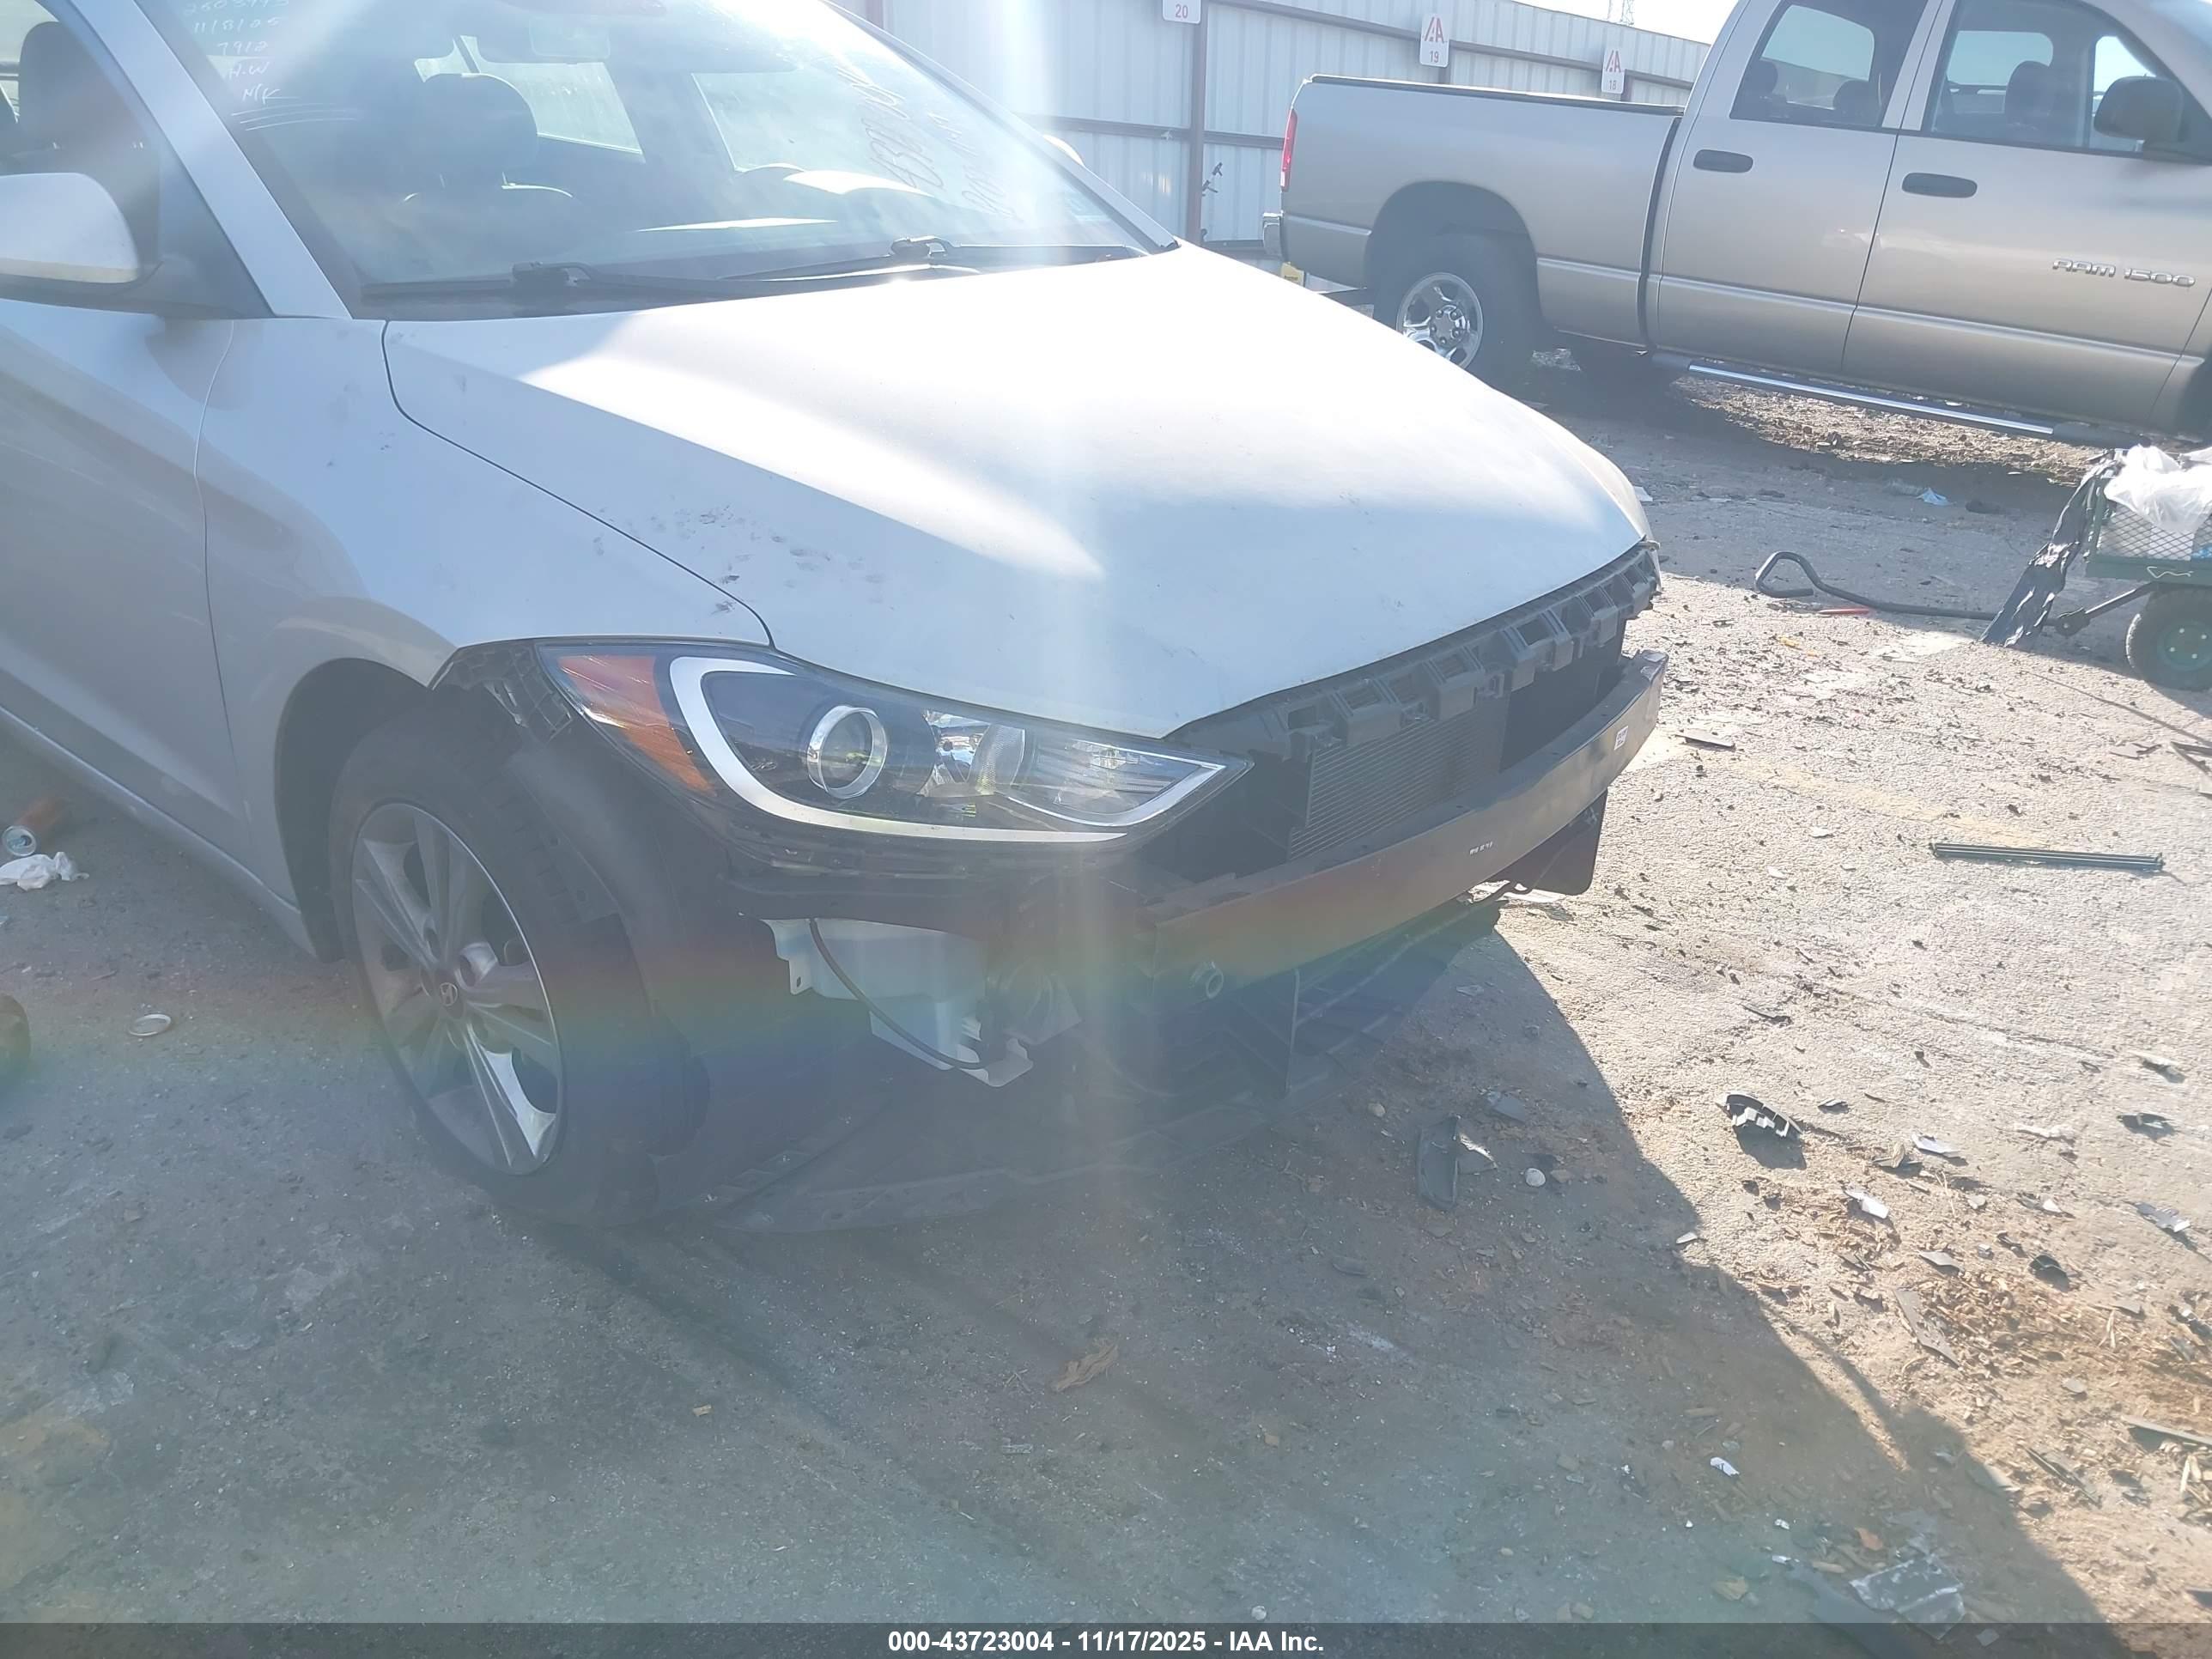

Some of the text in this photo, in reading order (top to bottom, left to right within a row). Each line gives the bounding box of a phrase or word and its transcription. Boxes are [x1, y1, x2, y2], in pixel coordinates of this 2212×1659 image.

[1176, 3, 1188, 18] 20
[1430, 51, 1439, 63] 19
[2053, 258, 2195, 286] RAM 1500
